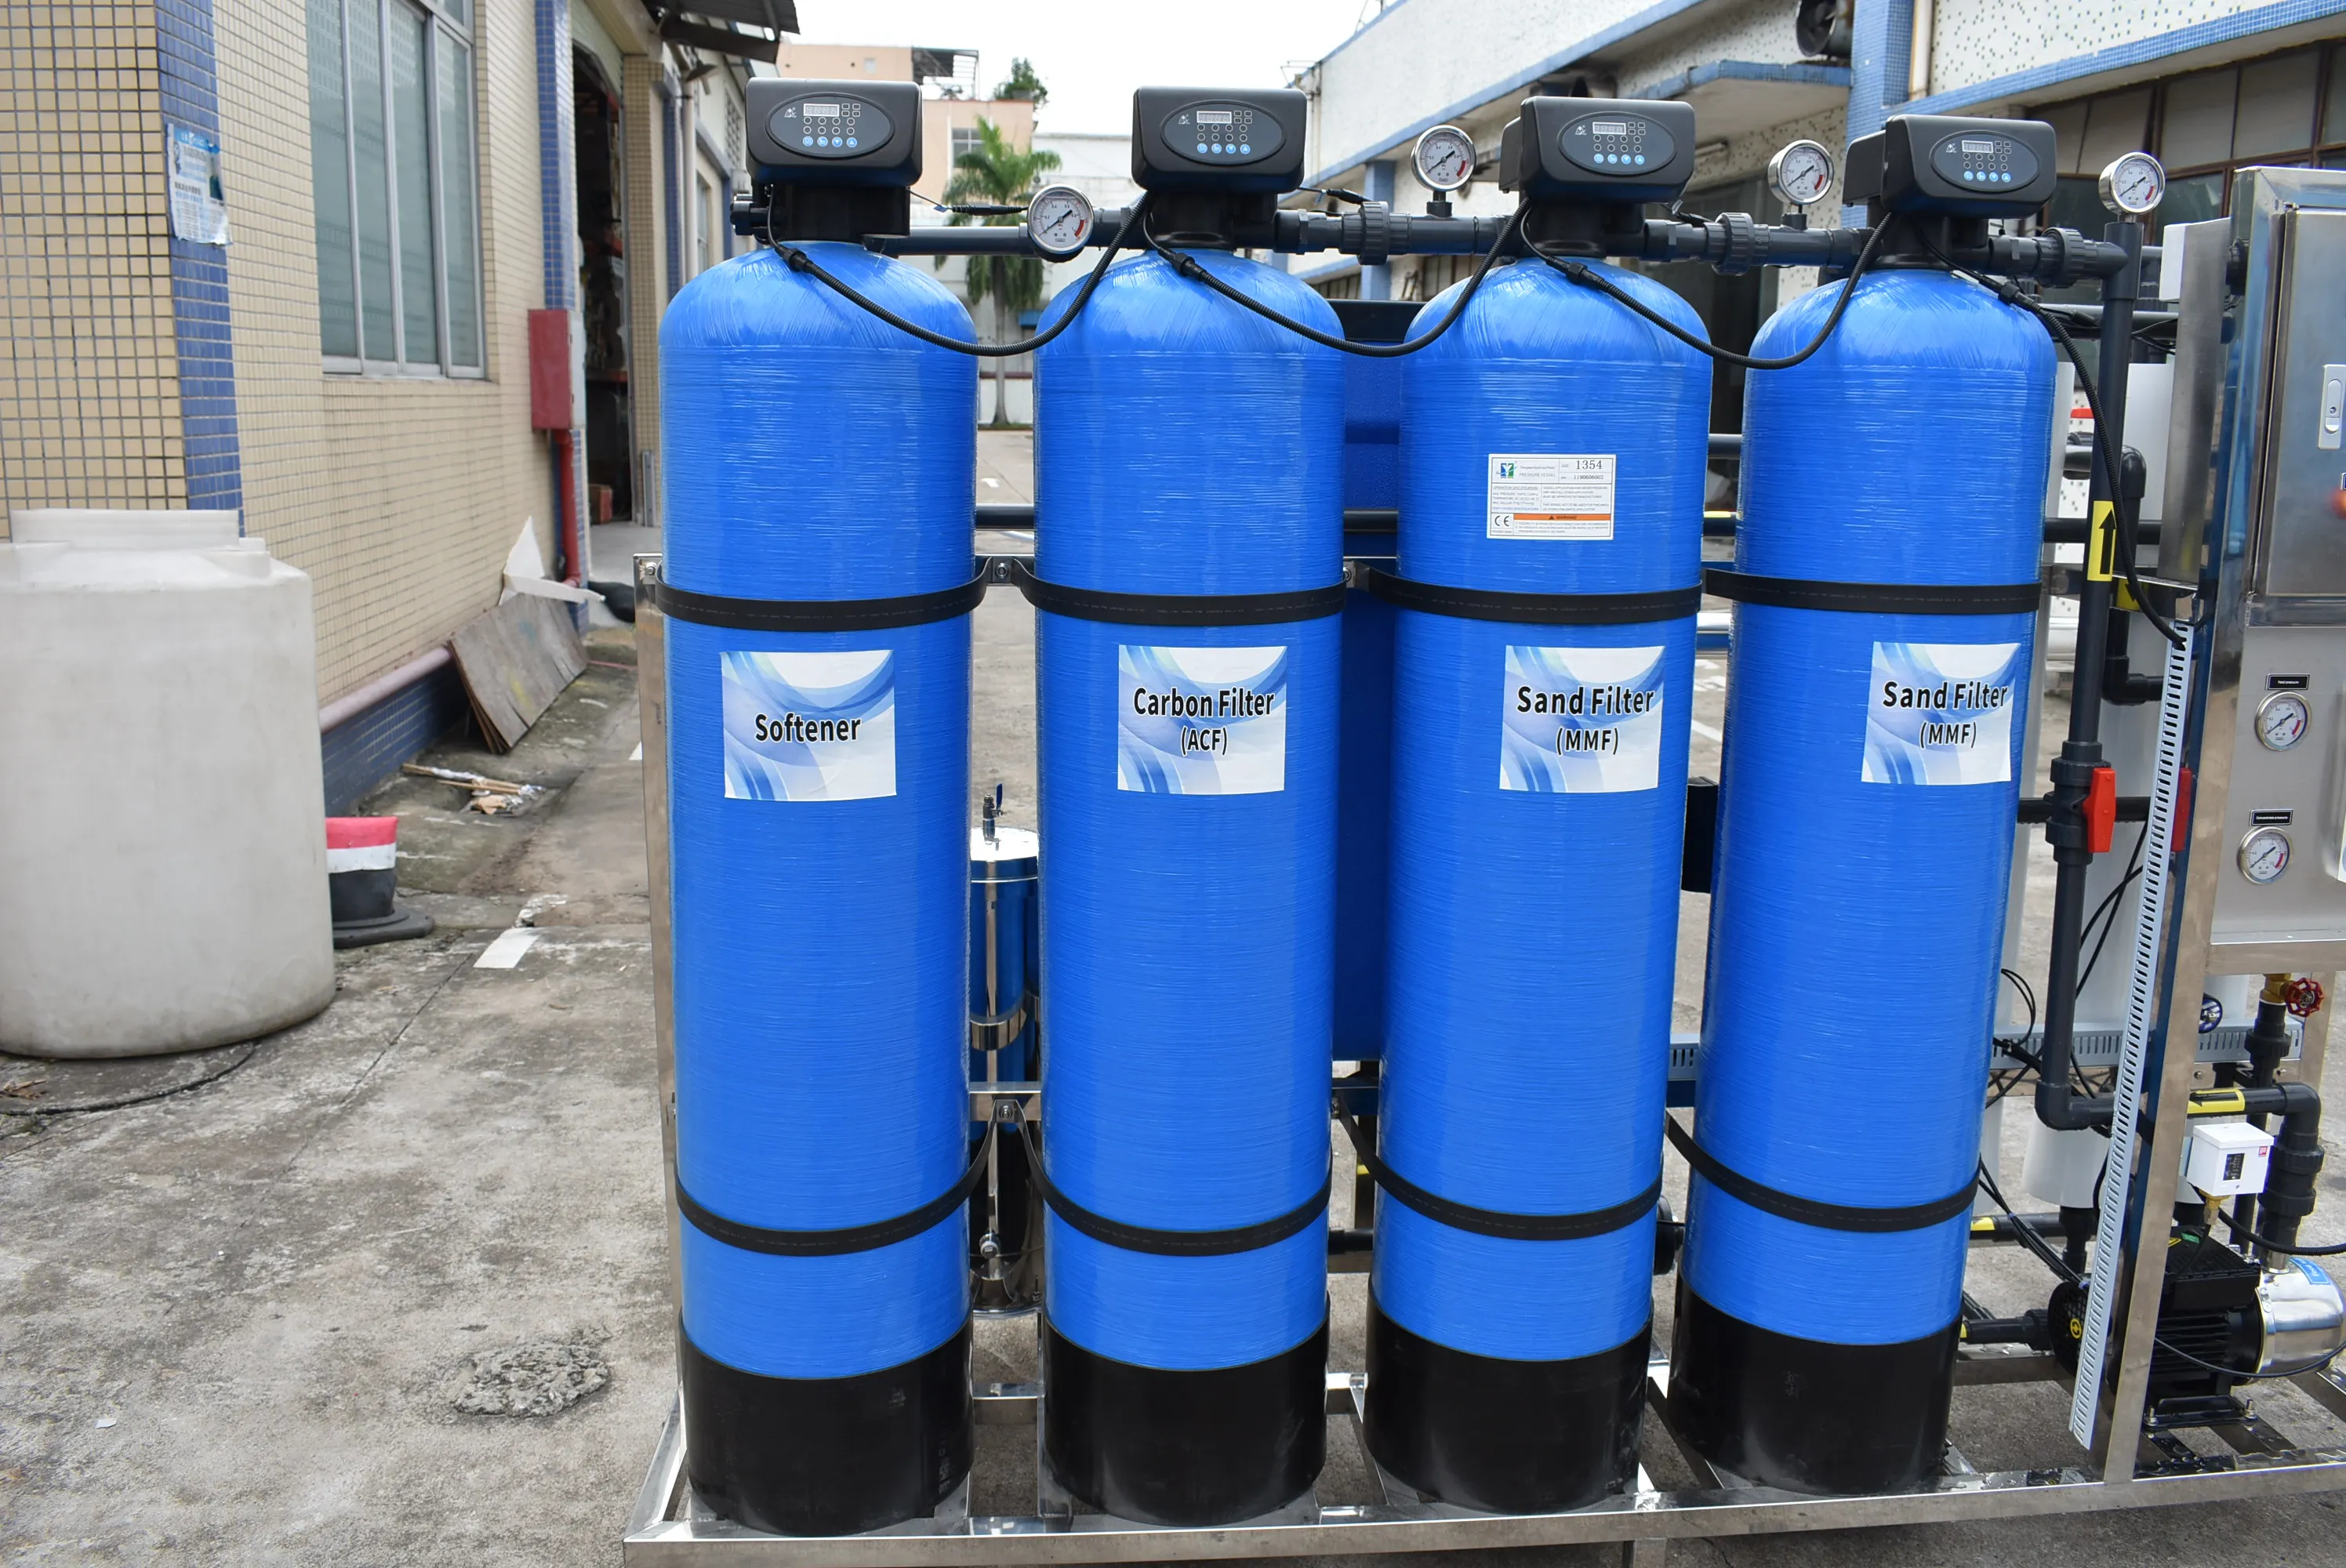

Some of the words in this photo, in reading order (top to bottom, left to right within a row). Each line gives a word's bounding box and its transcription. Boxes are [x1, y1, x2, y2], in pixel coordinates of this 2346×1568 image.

[1576, 459, 1603, 470] 1354
[1134, 688, 1212, 717] Carbon
[1218, 687, 1275, 717] Filter
[1517, 686, 1584, 714] Sand
[1591, 685, 1654, 714] Filter
[1883, 681, 1948, 709] Sand
[1953, 681, 2008, 709] Filter
[755, 713, 861, 742] Softener
[1181, 727, 1227, 756] (ACF)
[1920, 721, 1977, 749] (MMF)
[1556, 728, 1618, 756] (MMF)
